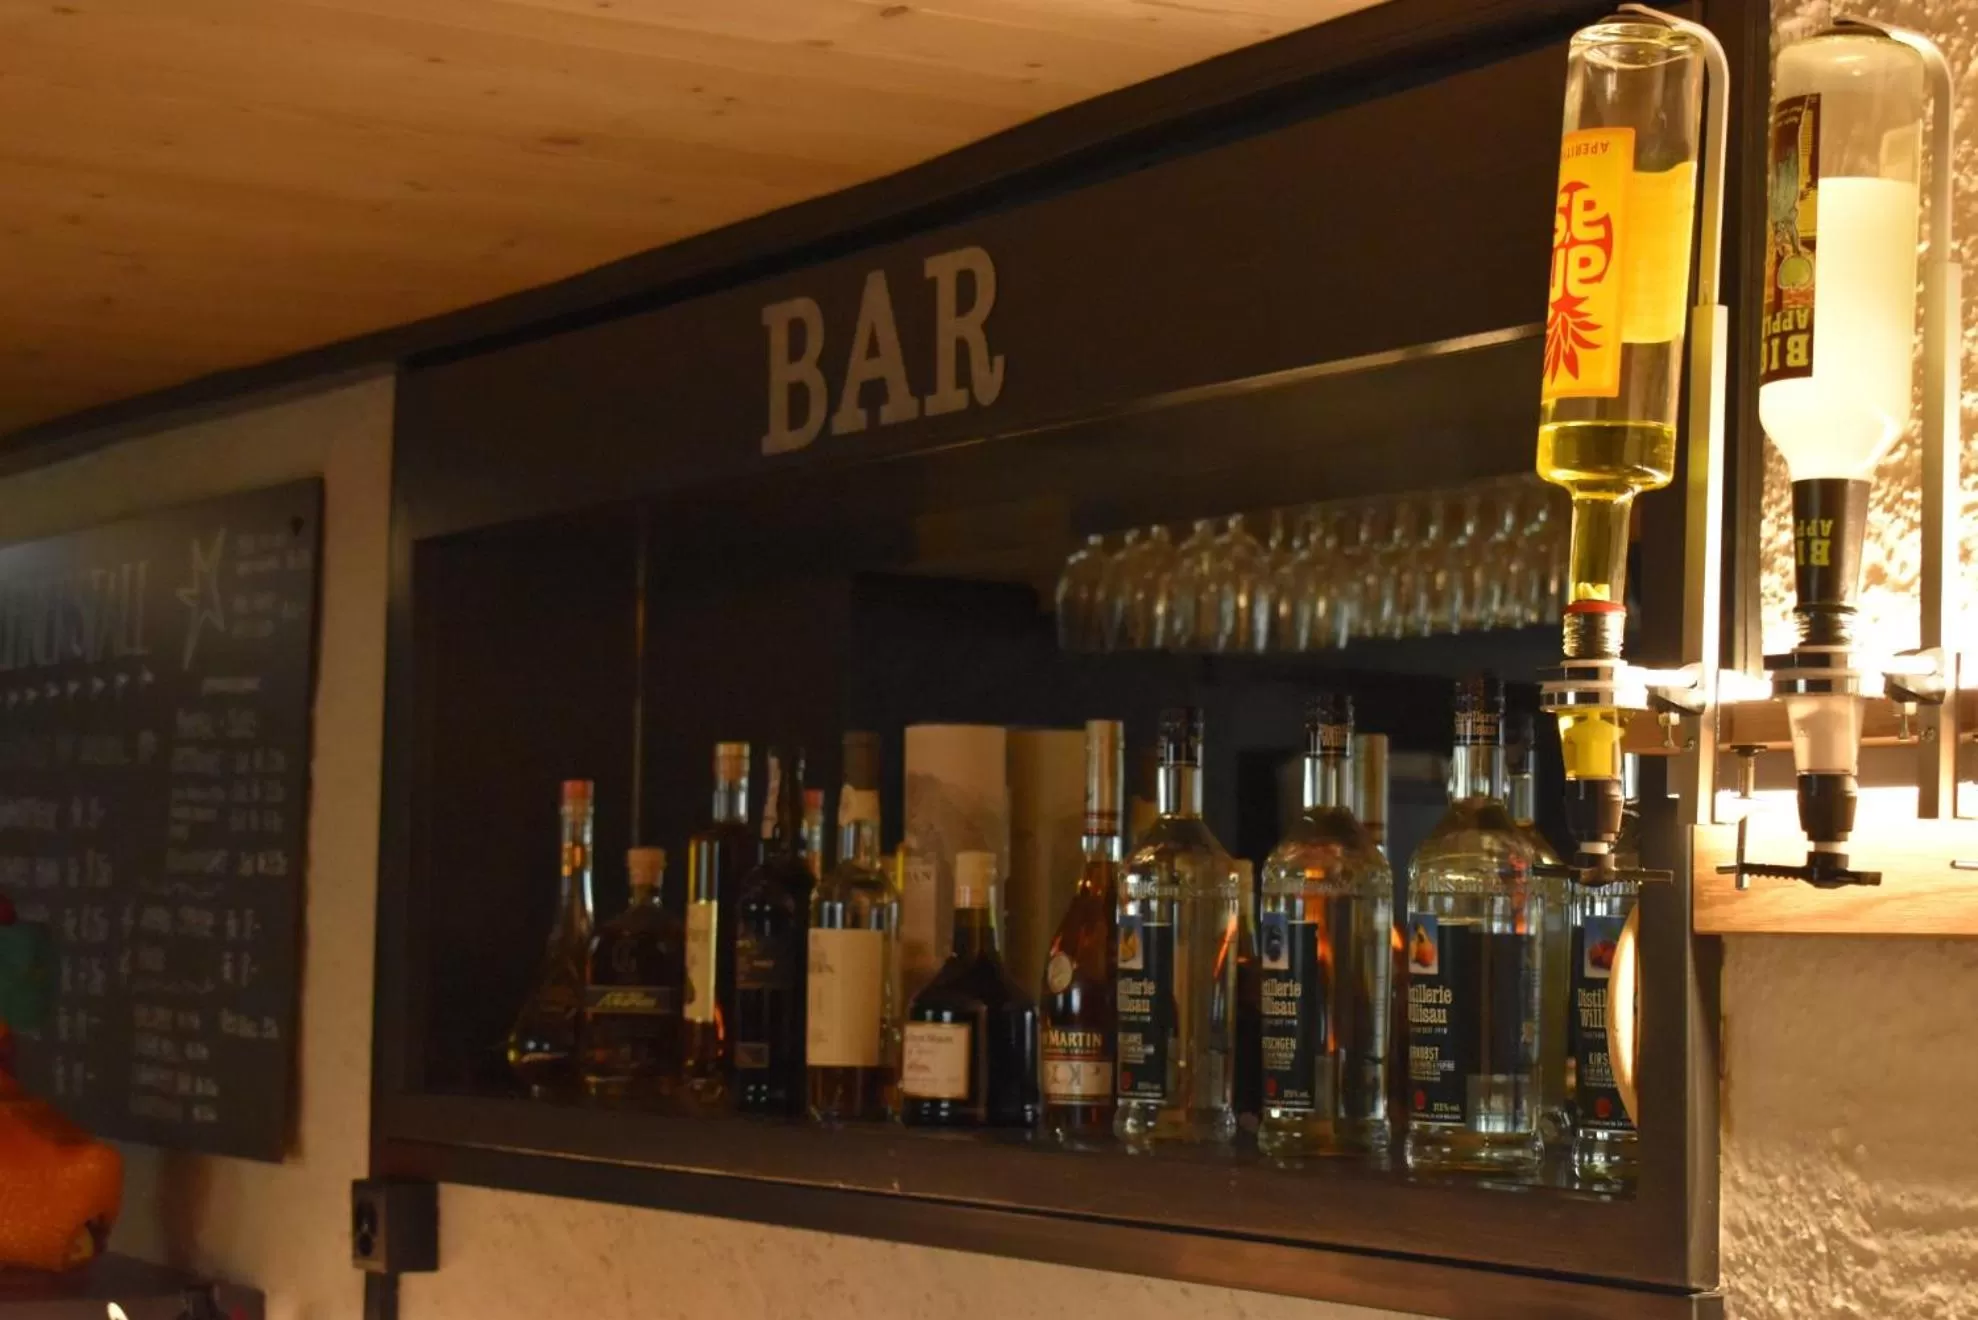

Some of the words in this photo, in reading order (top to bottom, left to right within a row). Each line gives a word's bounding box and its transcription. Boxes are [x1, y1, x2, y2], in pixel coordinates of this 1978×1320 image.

[1562, 142, 1611, 161] APERIT
[761, 246, 1005, 456] BAR
[1049, 1027, 1102, 1047] MARTIN
